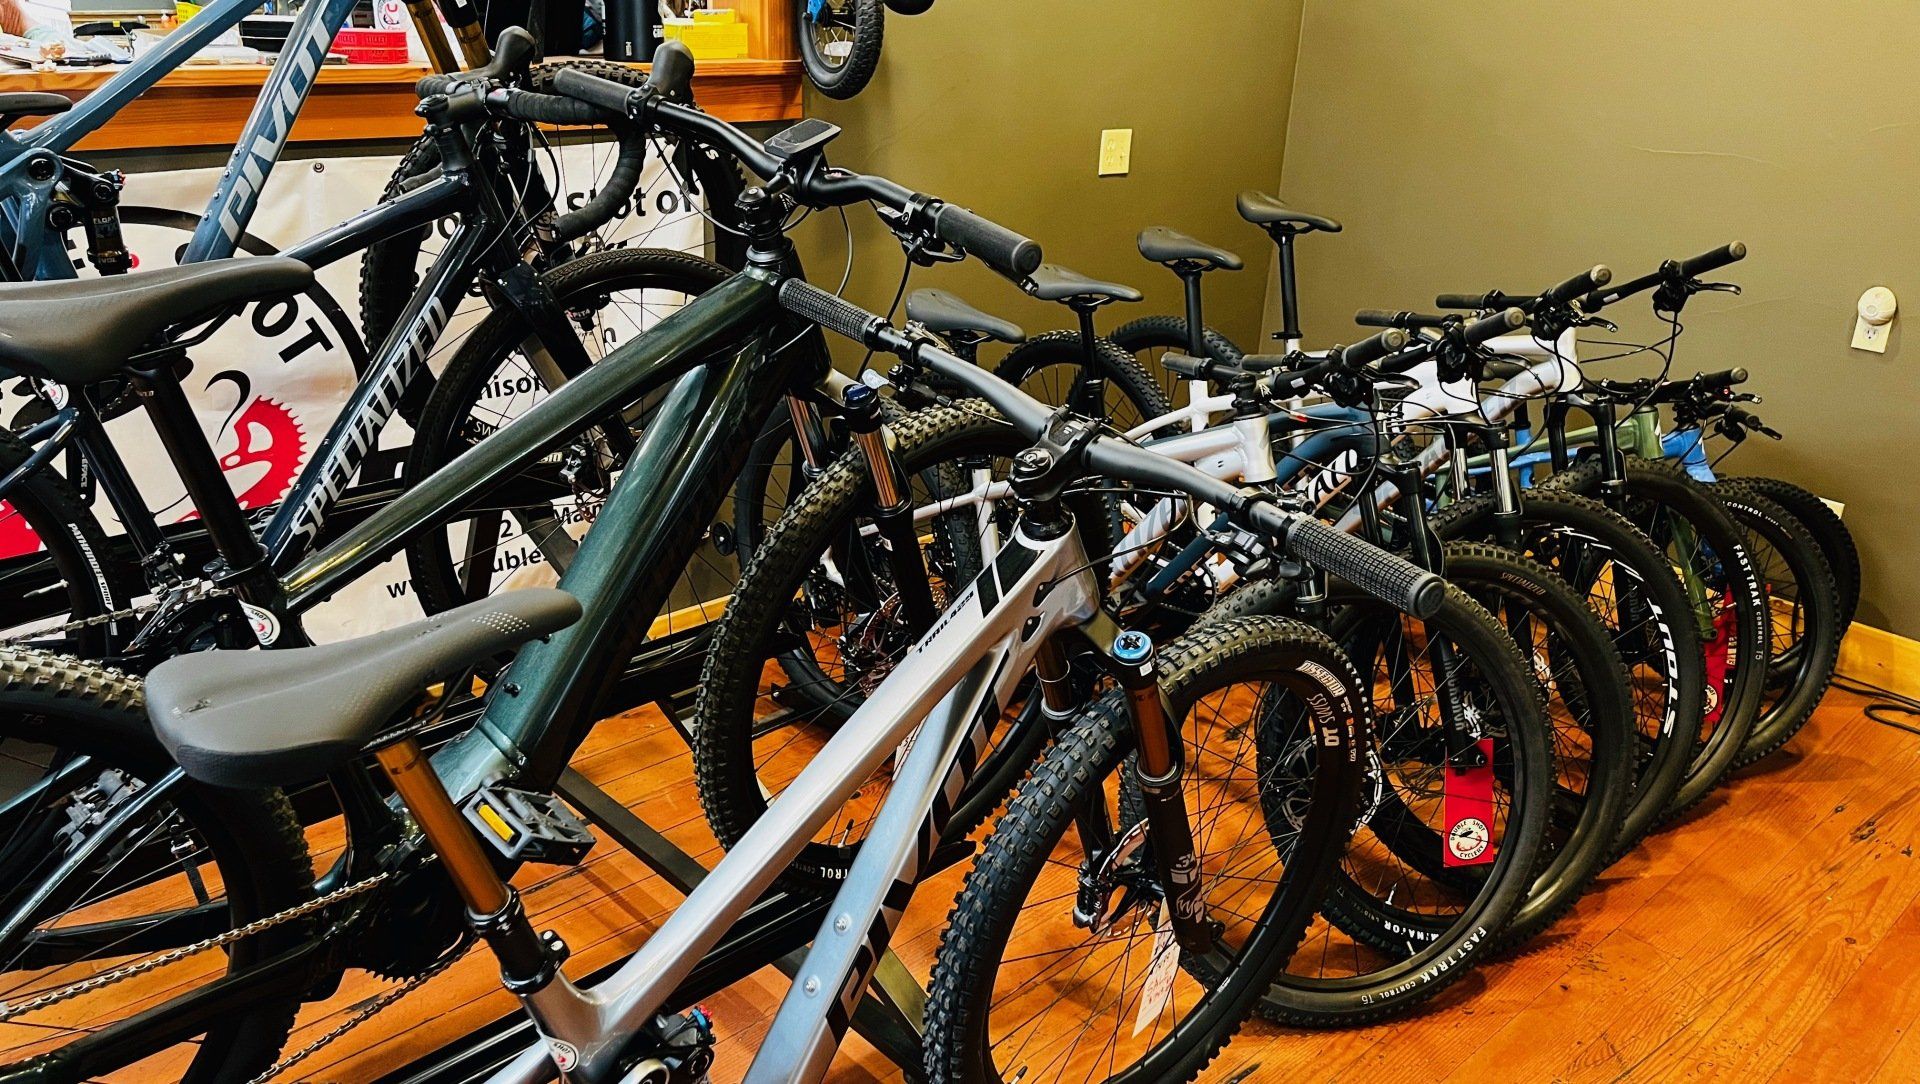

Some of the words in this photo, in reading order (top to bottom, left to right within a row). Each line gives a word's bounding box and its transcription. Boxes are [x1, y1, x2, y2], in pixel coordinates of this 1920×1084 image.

[219, 17, 332, 243] PIVOT
[290, 296, 447, 551] SPECIALIZED
[1726, 501, 1763, 518] CONTROL
[67, 522, 104, 582] PATHFINDER
[1733, 543, 1752, 573] FAST
[1746, 573, 1761, 607] TRAK
[1755, 611, 1763, 645] CONTROL
[1647, 597, 1679, 738] STOUT
[1306, 693, 1336, 724] SWISS
[1322, 726, 1340, 747] DT
[1472, 820, 1486, 832] SHOT
[1459, 845, 1484, 858] CYCLERY
[1456, 926, 1487, 959] FAST
[1419, 955, 1457, 984] TRAK
[1379, 980, 1417, 999] CONTROL
